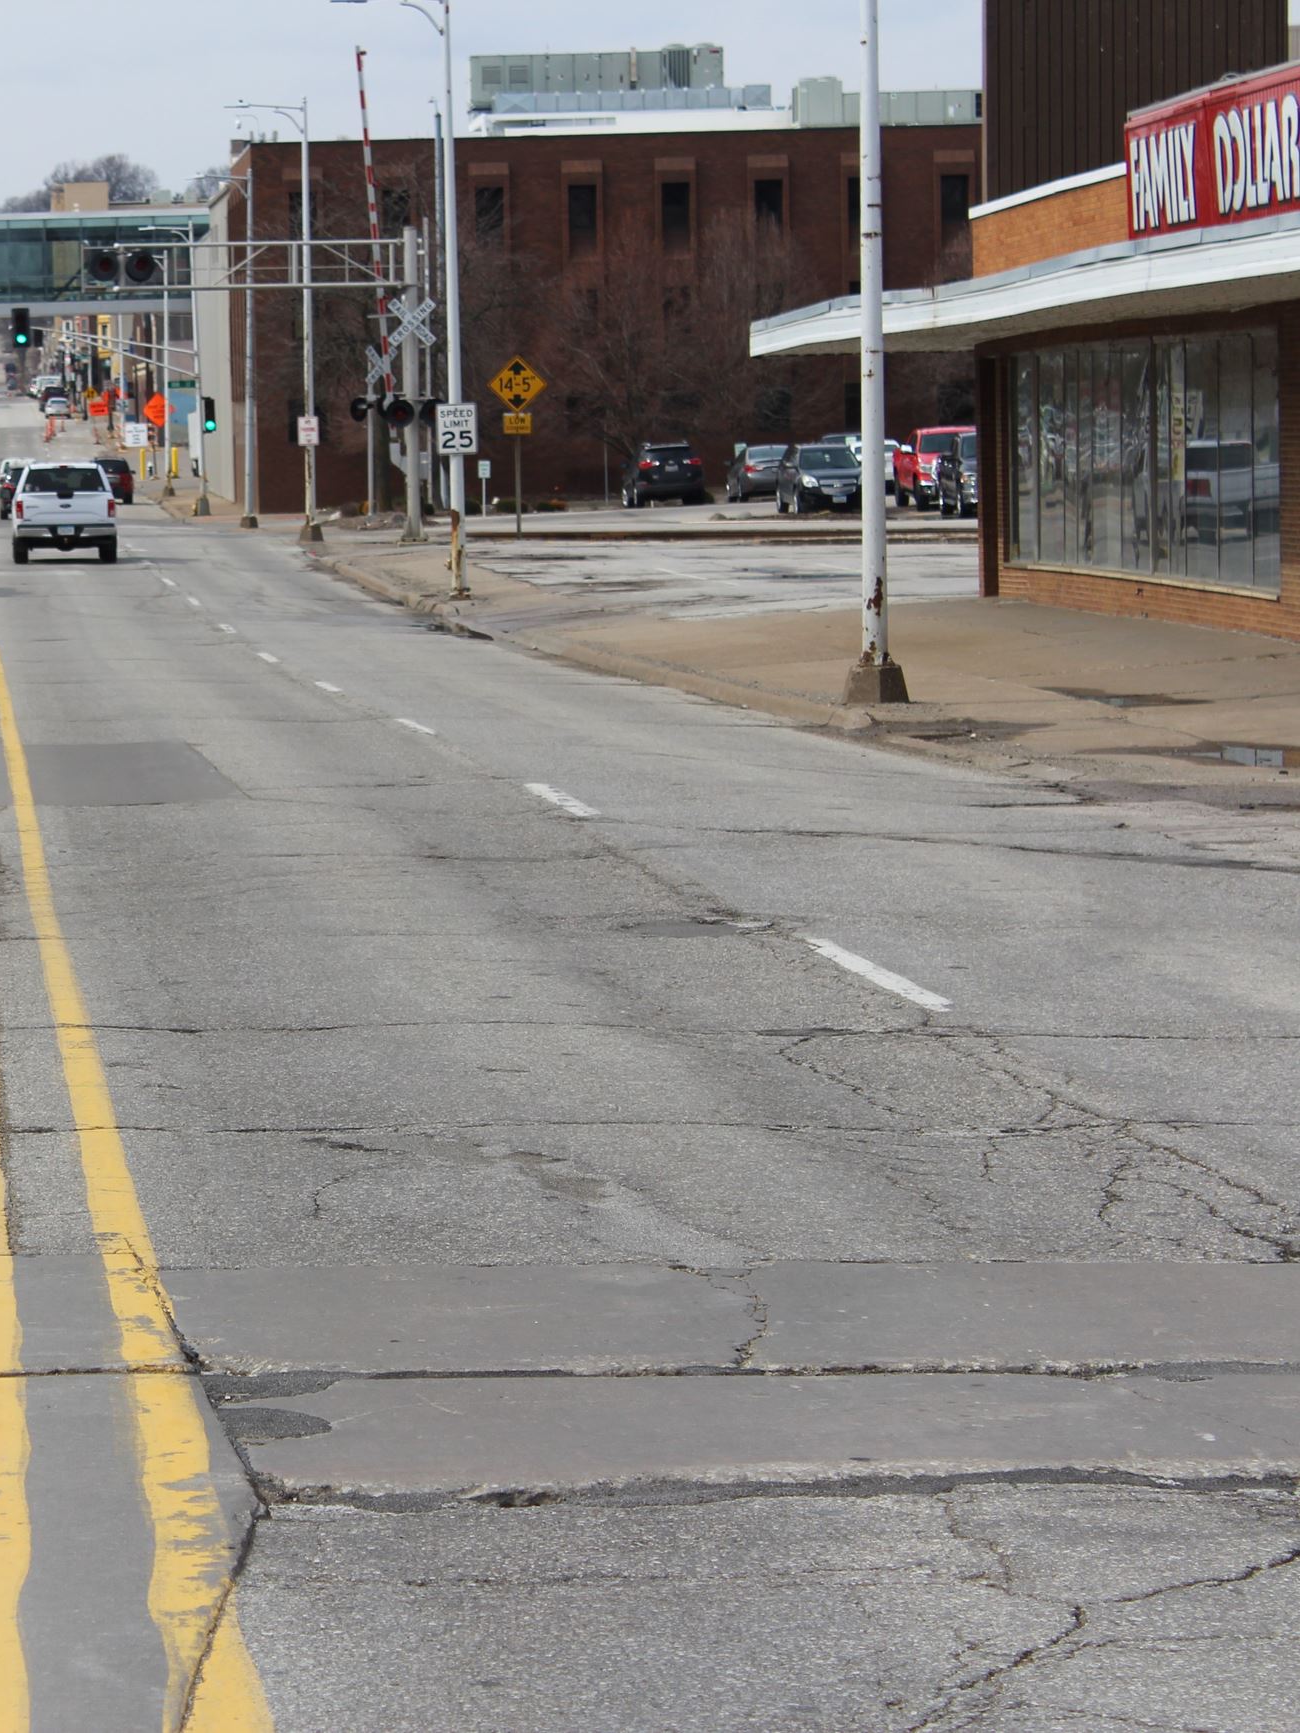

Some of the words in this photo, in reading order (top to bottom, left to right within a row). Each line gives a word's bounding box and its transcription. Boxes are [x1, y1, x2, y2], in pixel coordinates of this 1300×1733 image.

[1129, 122, 1197, 232] FAMILY
[1213, 92, 1300, 215] DOLLAR
[392, 303, 432, 343] CROSSING
[414, 324, 434, 344] ROAD
[440, 409, 473, 418] SPEED
[509, 417, 526, 425] LOW
[443, 420, 469, 429] LIMIT
[442, 430, 473, 449] 25
